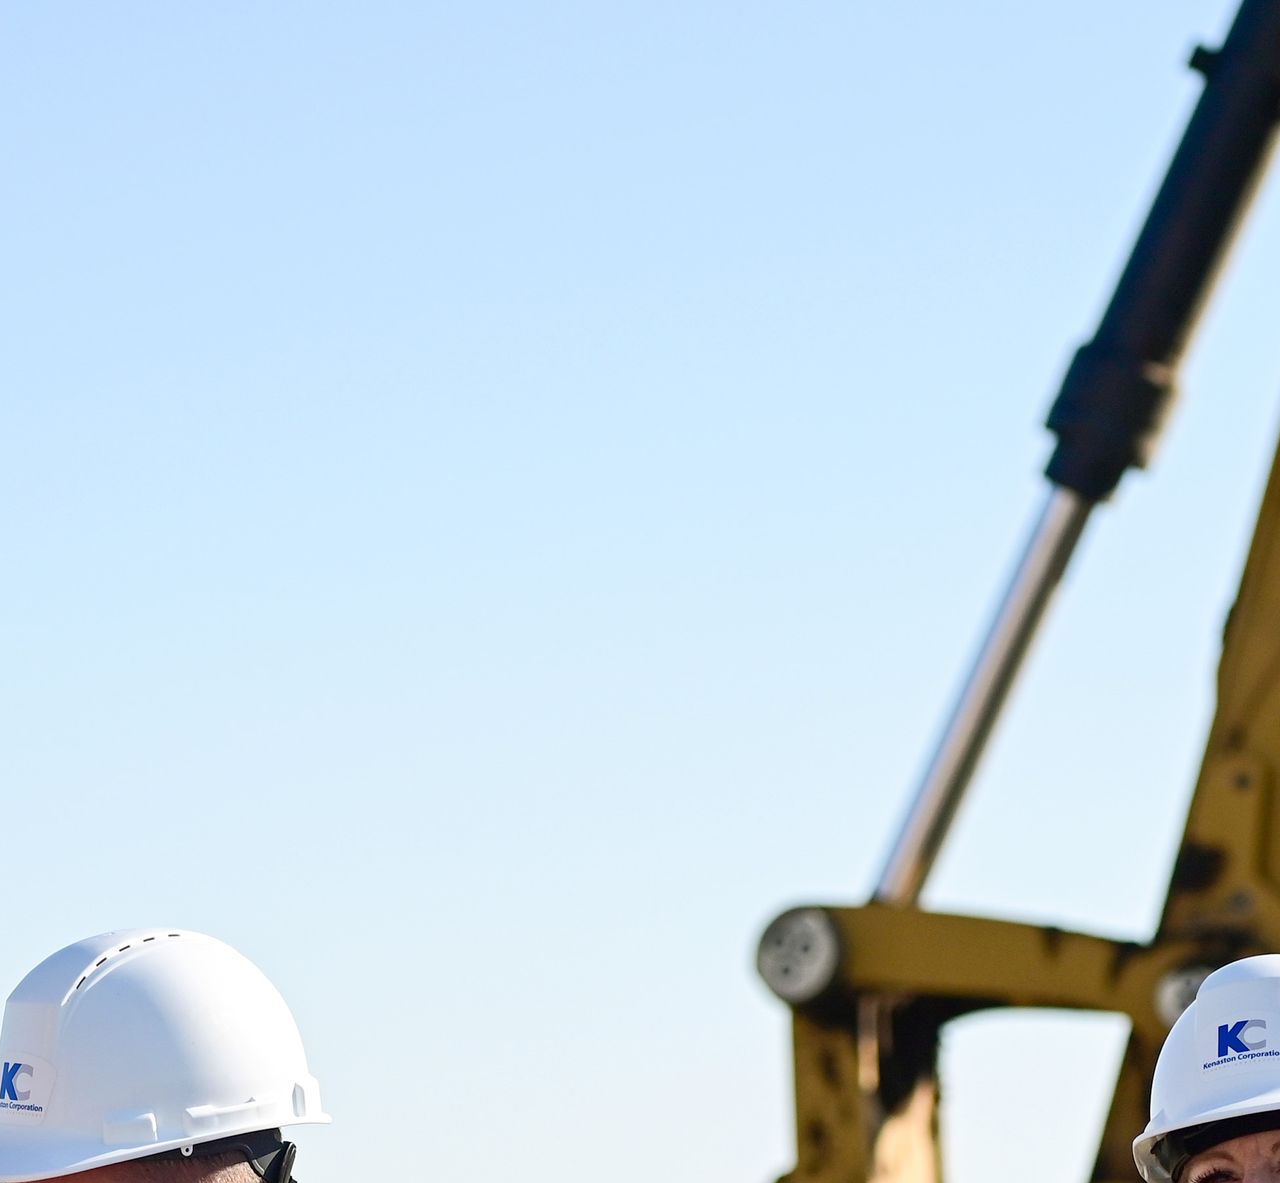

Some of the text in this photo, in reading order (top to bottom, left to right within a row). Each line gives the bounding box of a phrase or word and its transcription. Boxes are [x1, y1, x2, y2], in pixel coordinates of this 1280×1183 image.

[1217, 1019, 1267, 1058] KC
[1203, 1056, 1237, 1070] Kenaston
[0, 1062, 34, 1101] KC
[9, 1102, 43, 1113] Corporation
